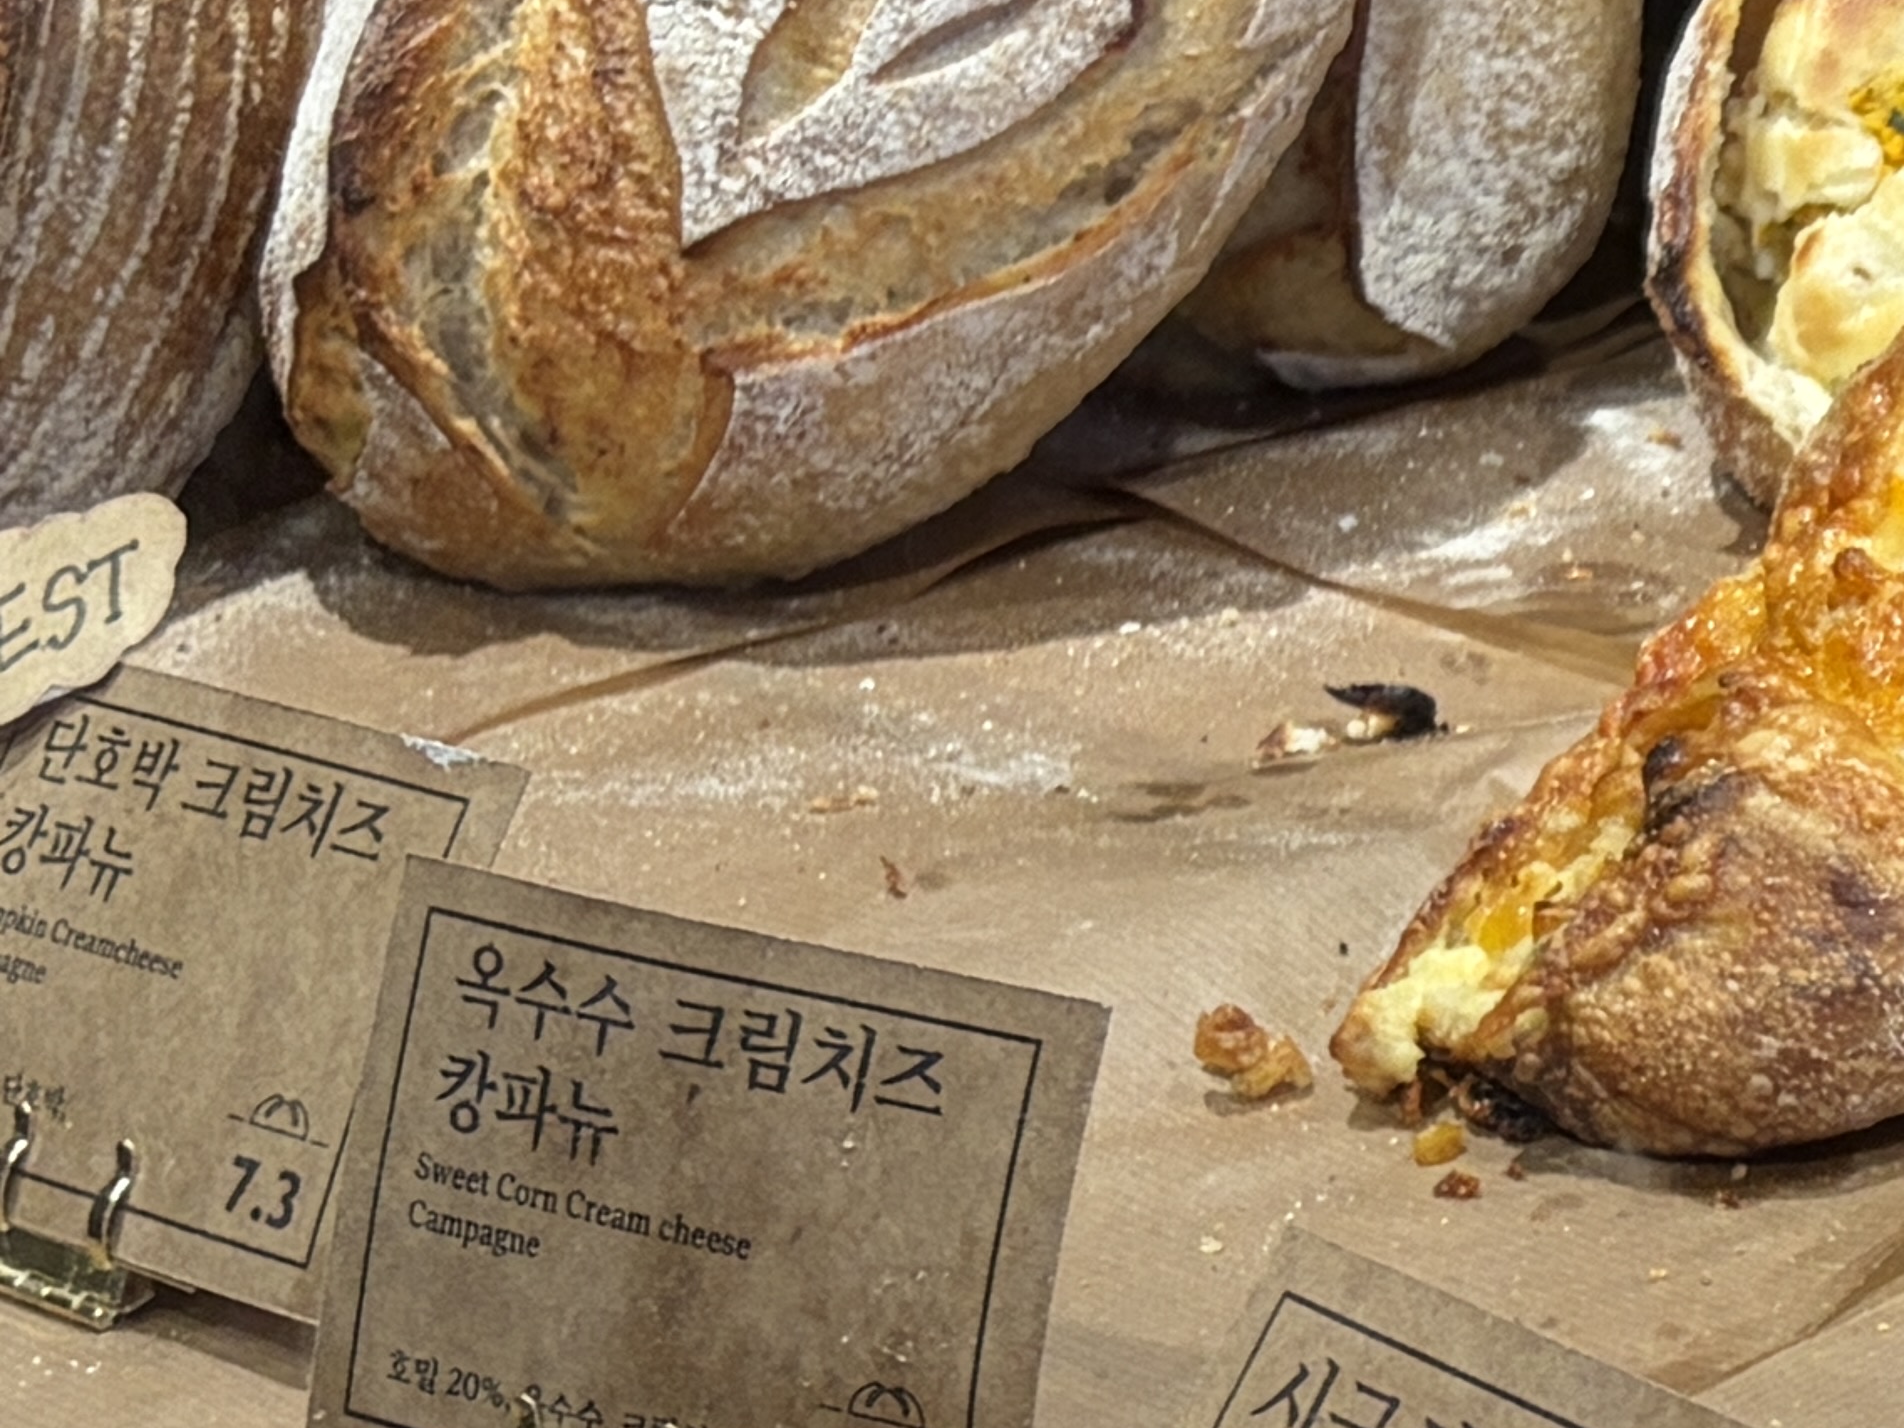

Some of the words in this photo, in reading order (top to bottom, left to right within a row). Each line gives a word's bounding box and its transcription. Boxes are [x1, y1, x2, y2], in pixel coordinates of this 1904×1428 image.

[38, 714, 181, 811] 단호박
[181, 759, 391, 861] 크림치즈
[0, 803, 133, 903] 캉파뉴
[51, 917, 184, 980] Creamcheese
[456, 943, 634, 1057] 옥수수
[658, 996, 946, 1116] 크림치즈
[436, 1051, 620, 1168] 캉파뉴
[225, 1155, 300, 1229] 7.3
[408, 1200, 541, 1261] Campagne
[414, 1152, 490, 1196] Sweet
[496, 1174, 558, 1214] Corn
[565, 1190, 651, 1237] Cream
[658, 1212, 753, 1261] cheese
[386, 1350, 438, 1396] 호밀
[445, 1367, 511, 1414] 20%,
